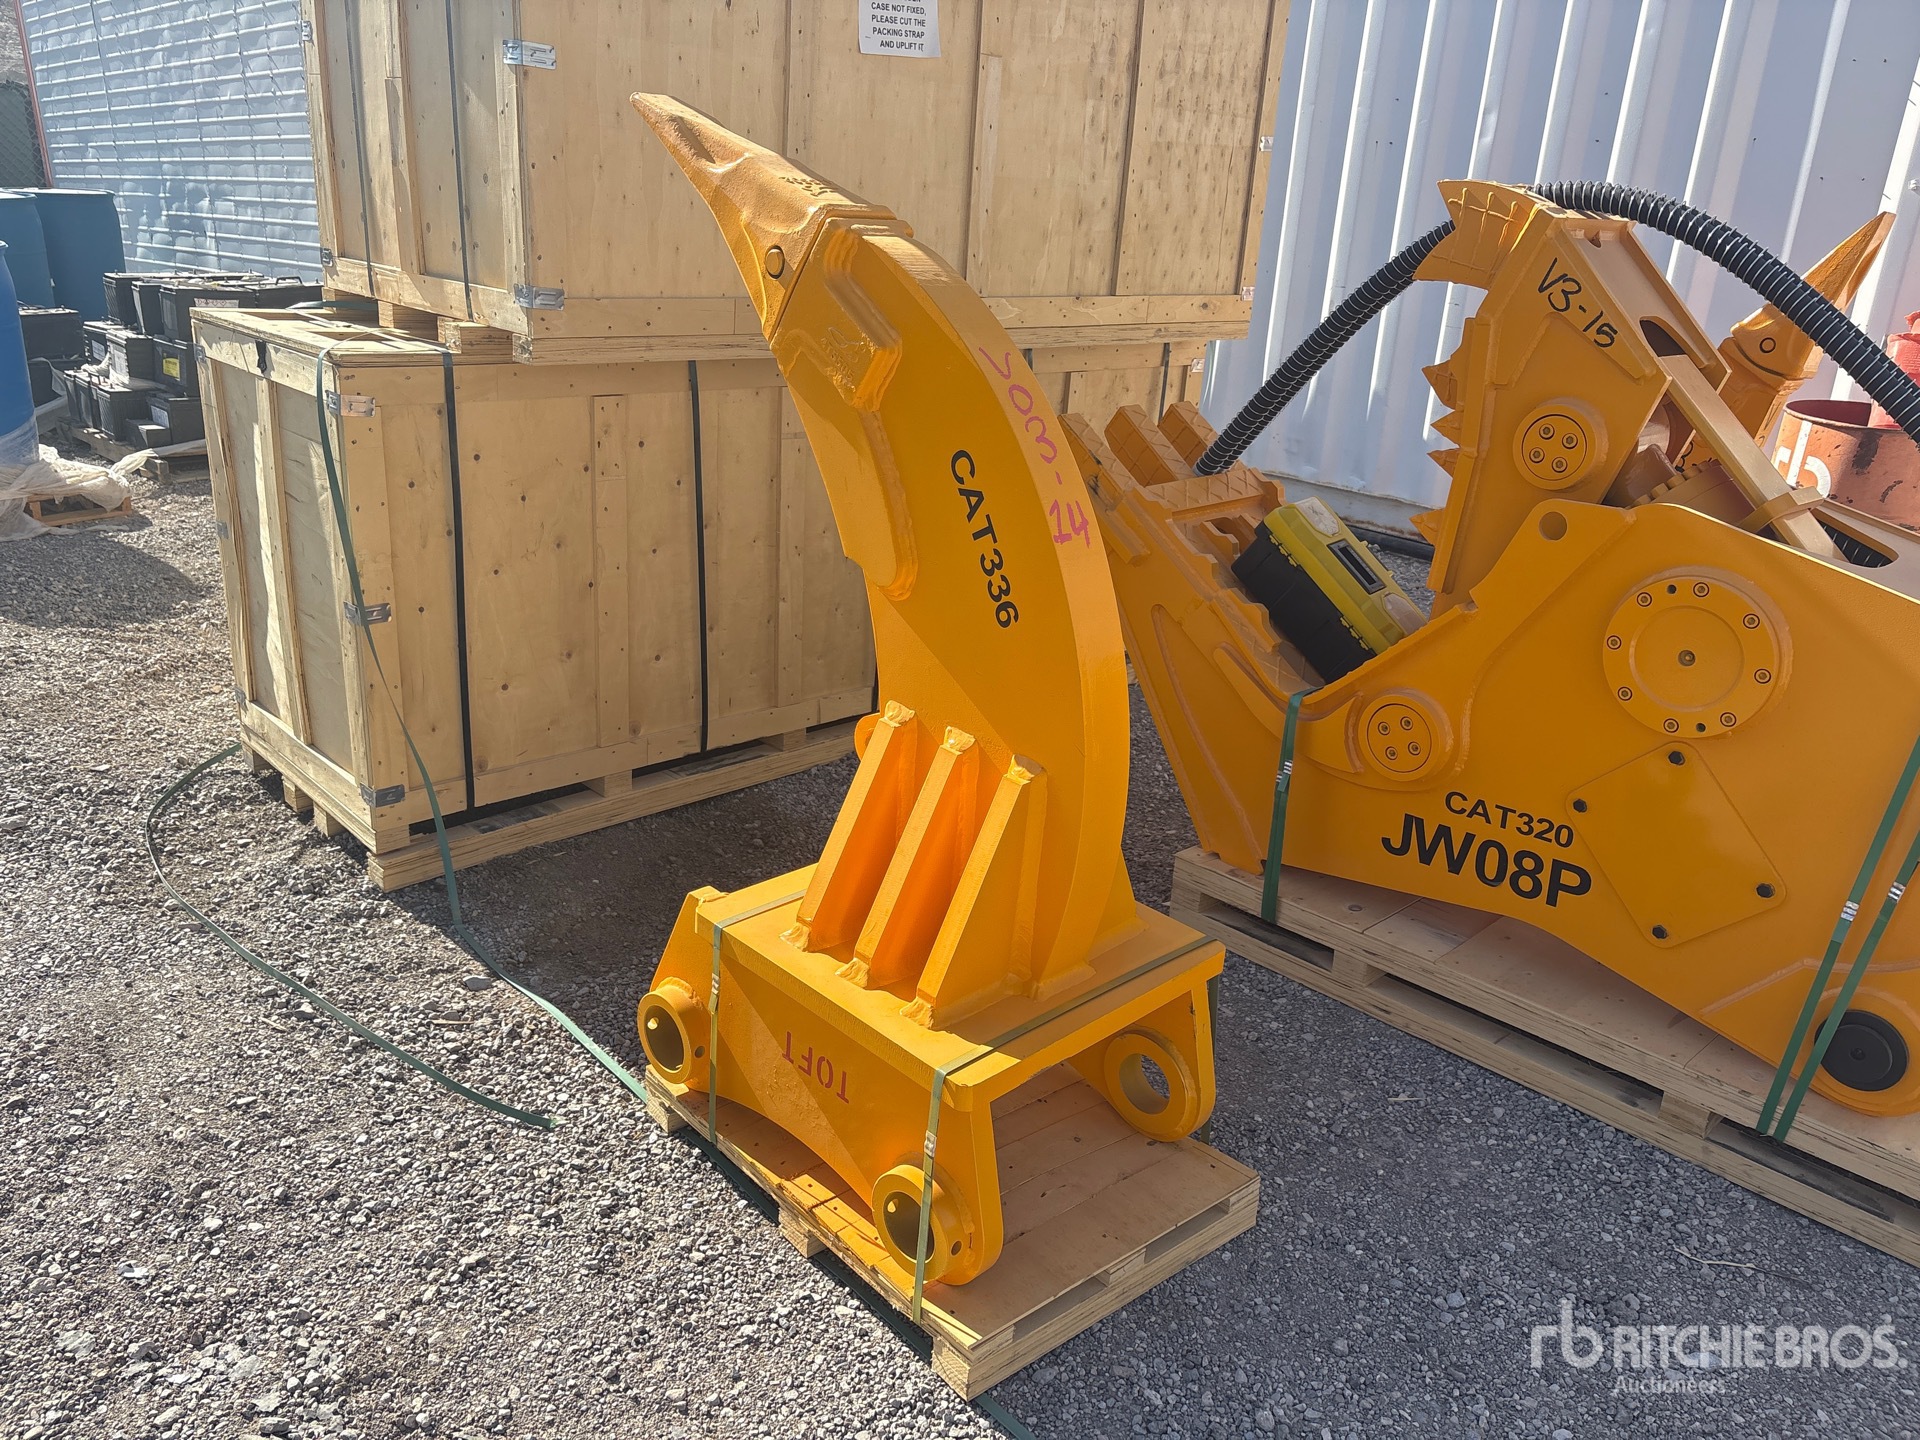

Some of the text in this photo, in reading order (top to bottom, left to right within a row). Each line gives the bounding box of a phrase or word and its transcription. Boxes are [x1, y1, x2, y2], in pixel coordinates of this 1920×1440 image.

[871, 2, 927, 16] CASE NOT FIXED,
[871, 14, 926, 28] PLEASE CUT THE
[872, 26, 925, 39] PACKING STRAP
[880, 40, 895, 49] AND
[896, 41, 918, 51] UPLIFT
[1538, 256, 1619, 347] V3-15
[950, 449, 1020, 629] CAT336
[1445, 791, 1575, 848] CAT320
[1381, 813, 1592, 908] JW08P
